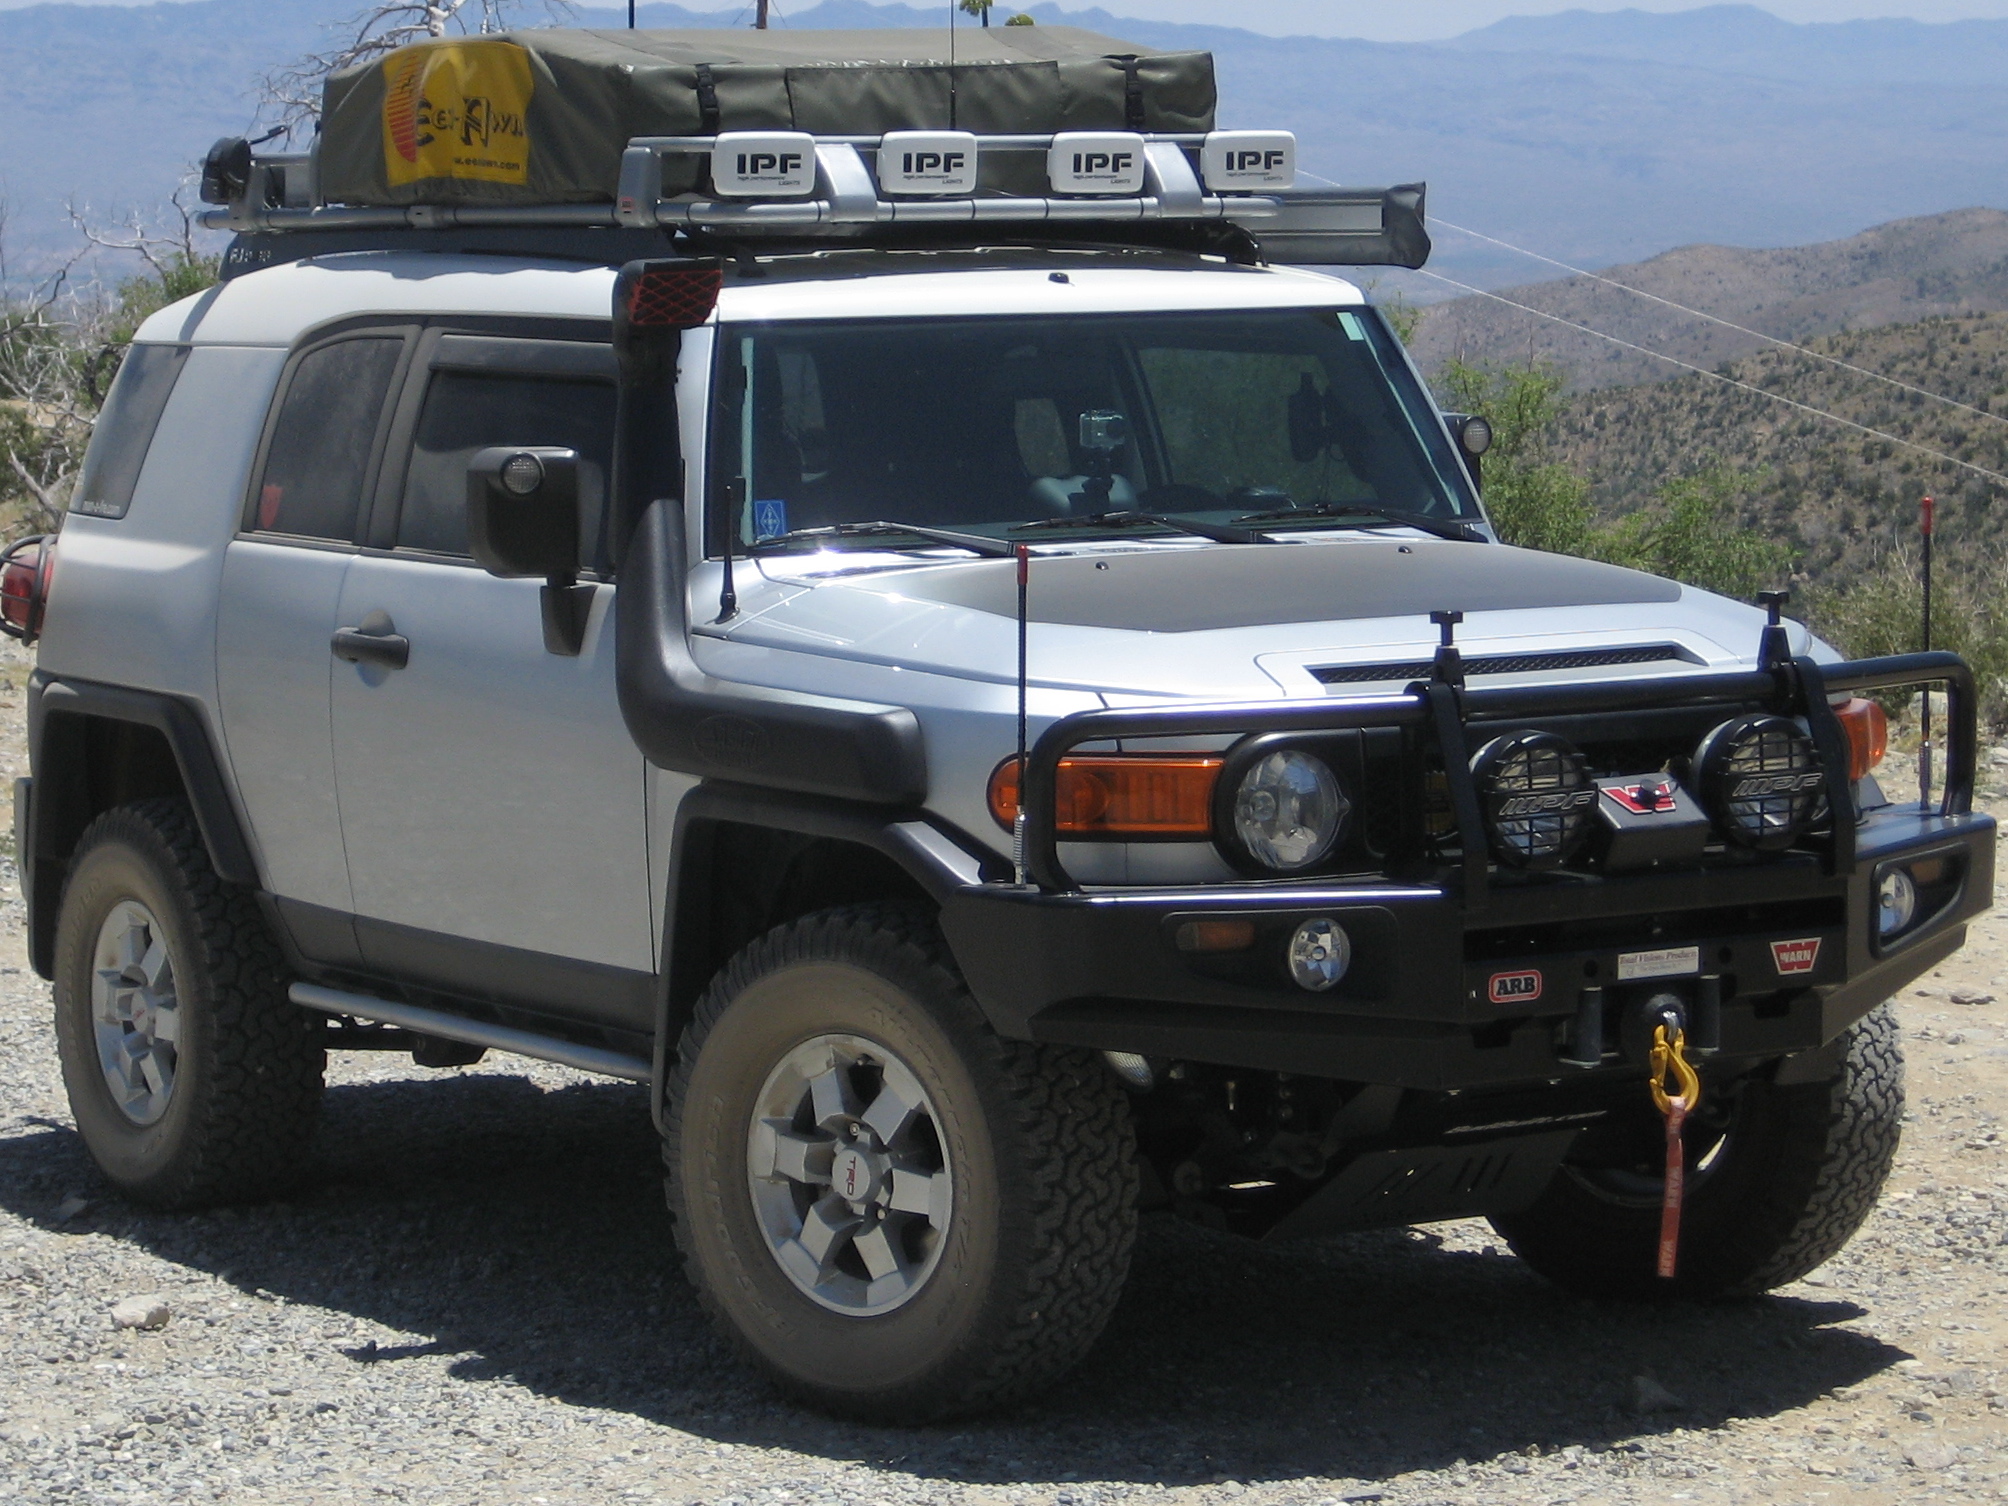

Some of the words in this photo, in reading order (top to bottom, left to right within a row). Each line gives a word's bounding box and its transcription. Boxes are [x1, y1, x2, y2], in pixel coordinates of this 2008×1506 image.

[737, 153, 802, 174] IPF
[903, 152, 964, 173] IPF
[1073, 153, 1132, 173] IPF
[1226, 150, 1284, 170] IPF
[1779, 949, 1811, 963] WARN
[1495, 976, 1536, 996] ARB
[845, 1156, 857, 1196] TRD
